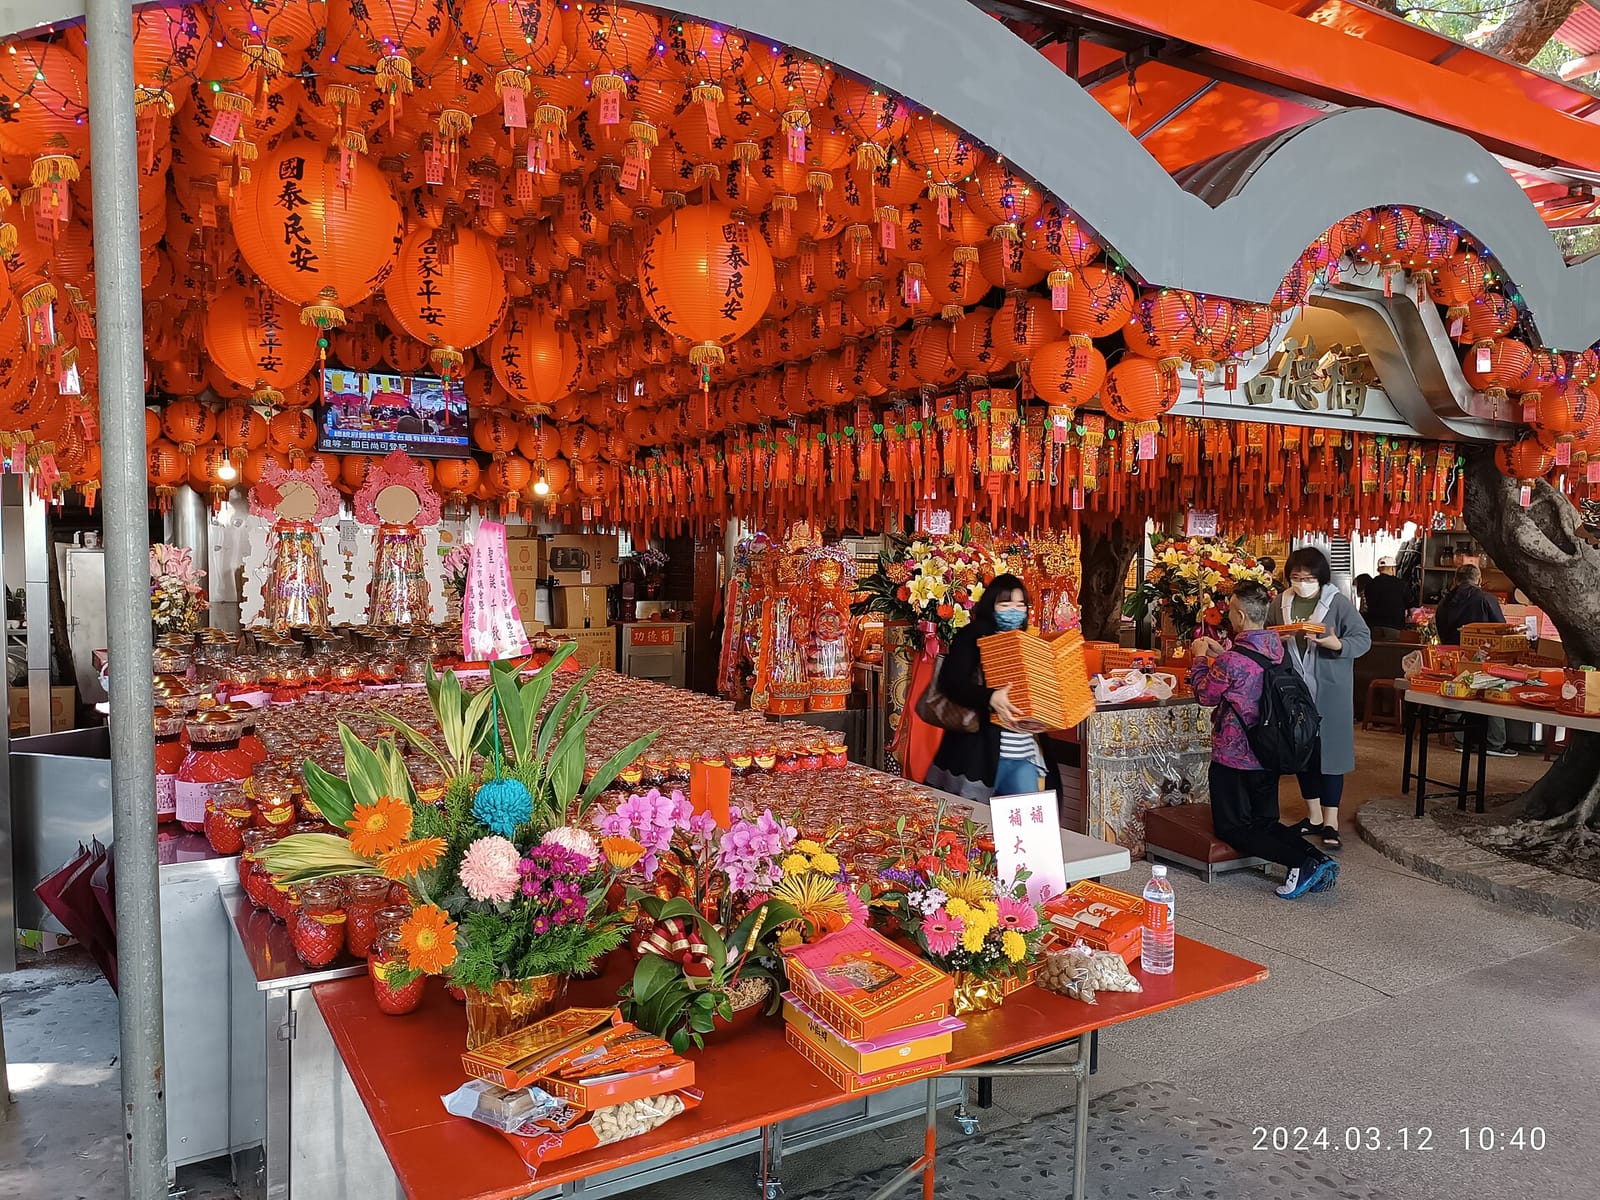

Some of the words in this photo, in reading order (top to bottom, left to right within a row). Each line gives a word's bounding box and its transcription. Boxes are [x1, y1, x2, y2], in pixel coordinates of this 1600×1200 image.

[277, 157, 319, 273] 國泰民安
[417, 237, 445, 326] 合家平安
[720, 223, 750, 320] 國泰民安
